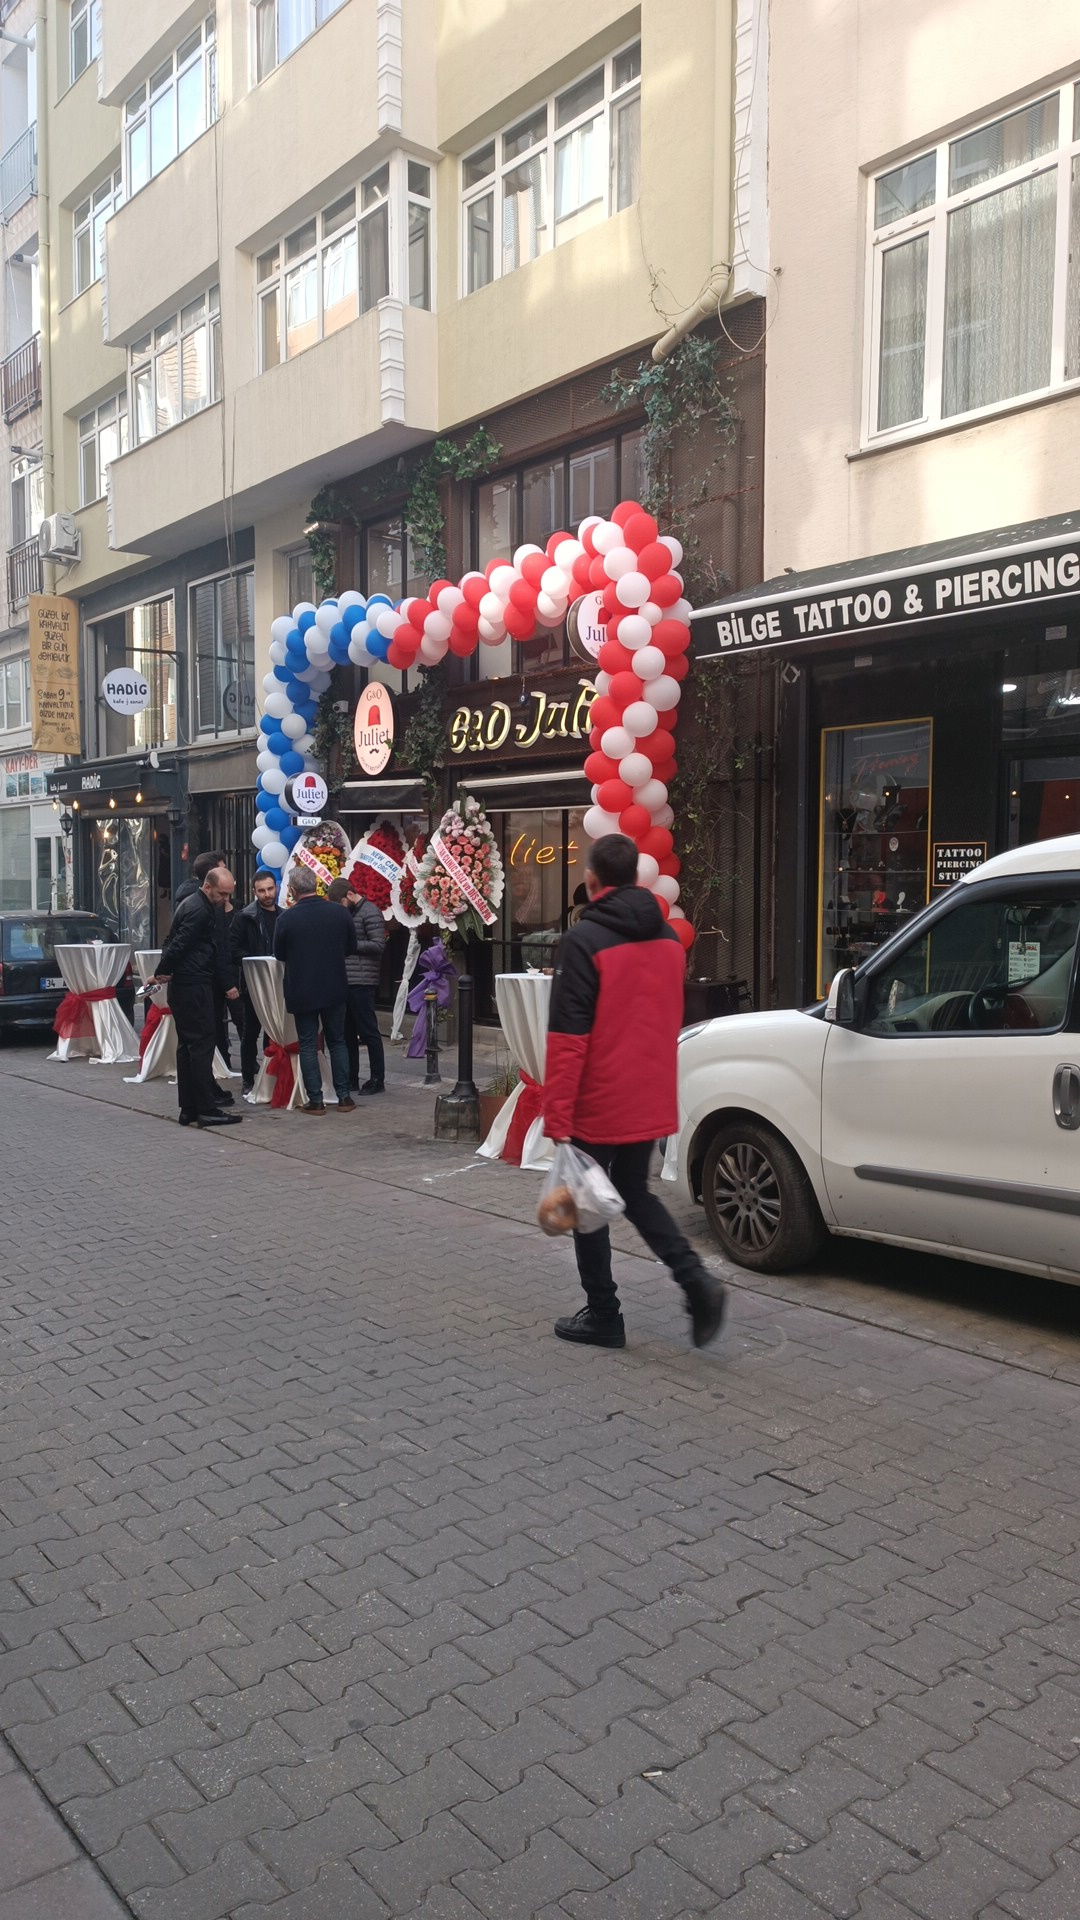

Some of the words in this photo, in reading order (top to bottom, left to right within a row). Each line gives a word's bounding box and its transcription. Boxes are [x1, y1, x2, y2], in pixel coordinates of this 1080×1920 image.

[717, 612, 782, 647] BİLGE
[793, 589, 892, 633] TATTOO
[903, 584, 923, 615] &
[935, 553, 1080, 610] PIERCING
[107, 681, 147, 695] HADİG
[359, 728, 390, 747] Juliet
[296, 789, 325, 799] Juliet
[937, 848, 982, 858] TATTOO
